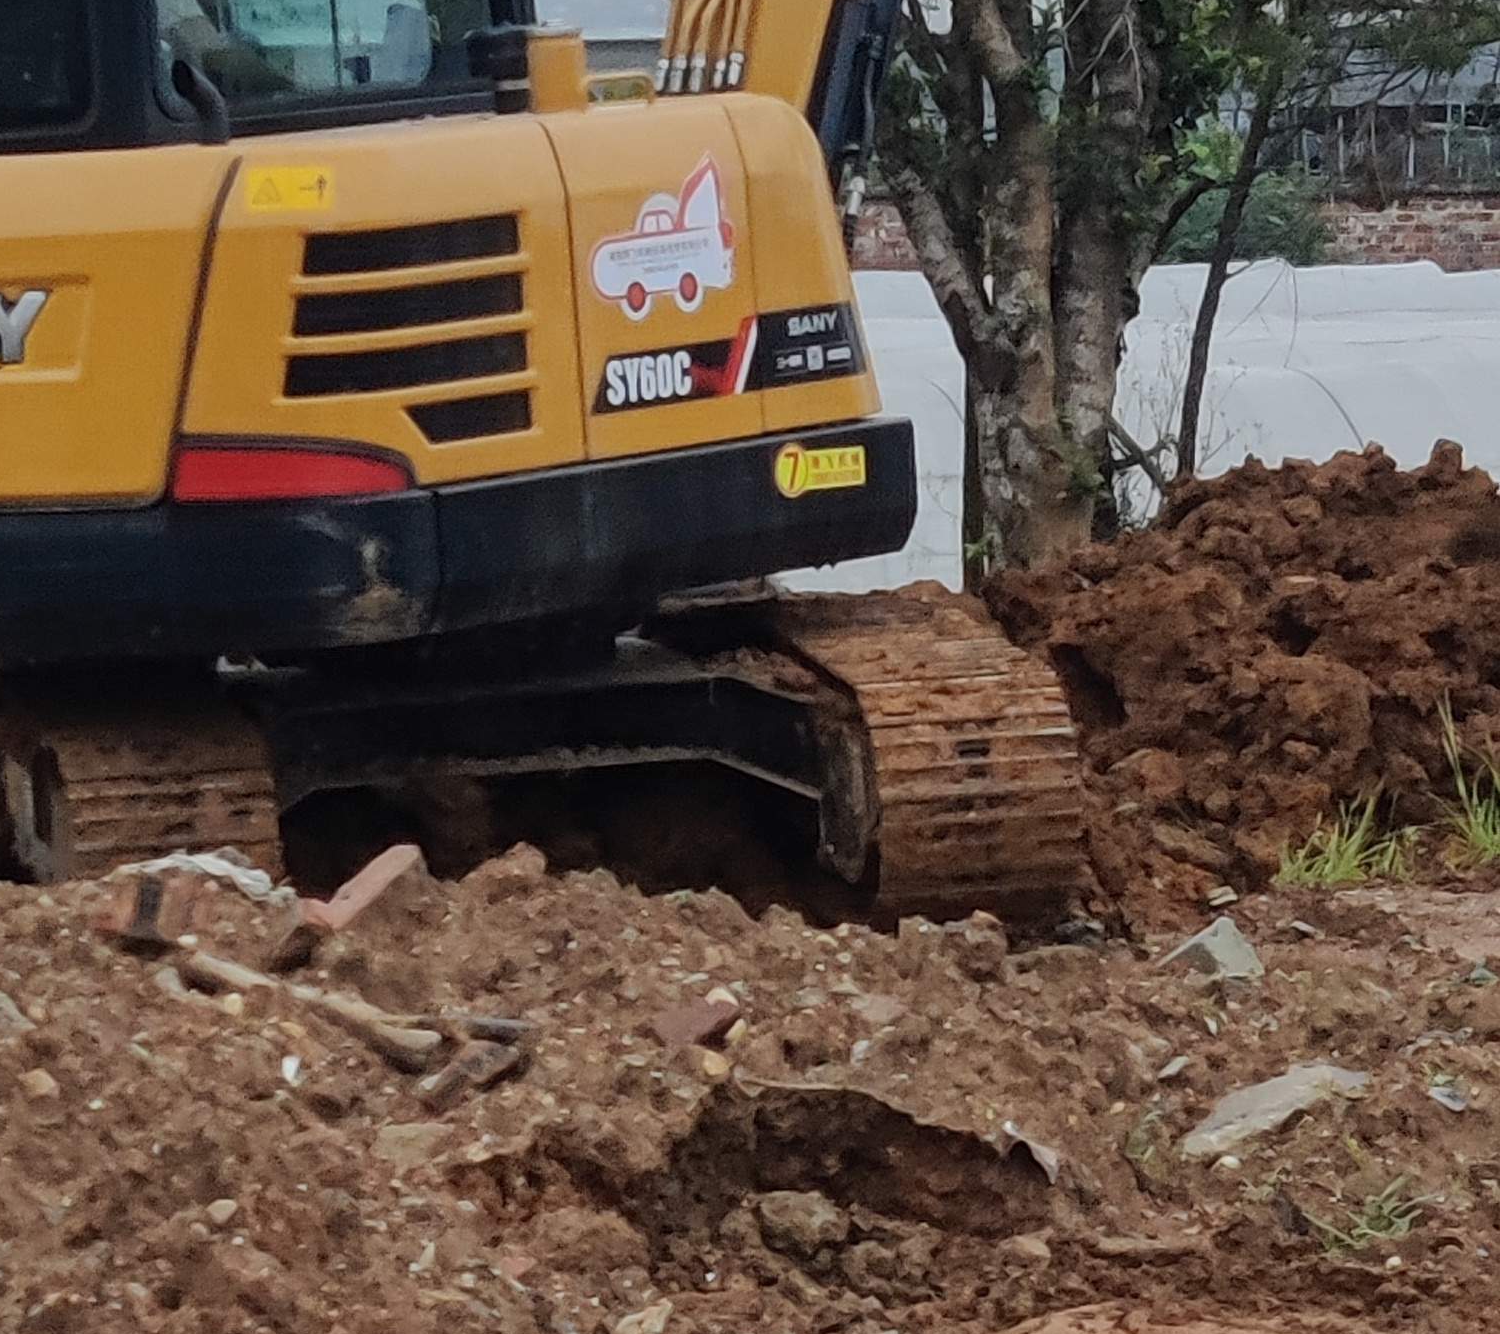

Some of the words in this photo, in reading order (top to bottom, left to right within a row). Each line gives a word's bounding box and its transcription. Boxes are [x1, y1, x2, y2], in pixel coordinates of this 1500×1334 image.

[787, 311, 838, 337] SANY
[606, 350, 692, 406] SY60C
[784, 452, 799, 492] 7
